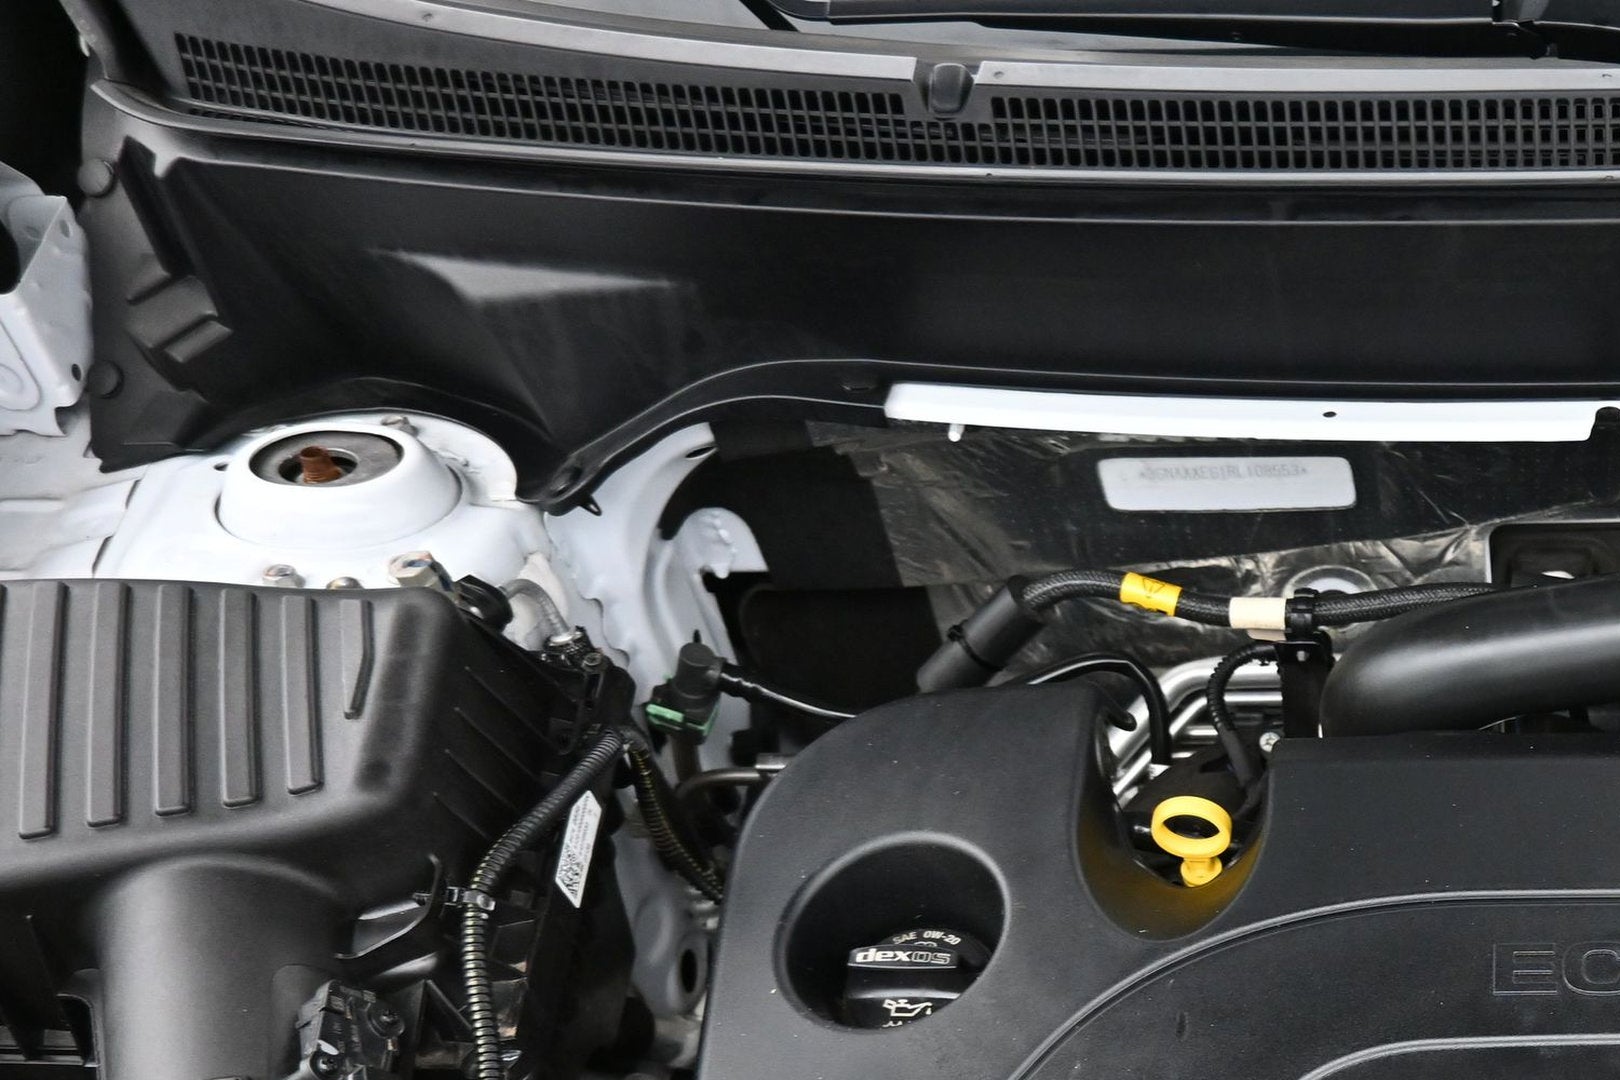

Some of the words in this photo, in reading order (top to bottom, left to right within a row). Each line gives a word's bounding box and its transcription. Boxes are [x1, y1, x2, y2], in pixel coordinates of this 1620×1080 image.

[892, 931, 917, 945] SAE
[922, 930, 962, 945] 0W-20
[855, 948, 951, 964] dexos
